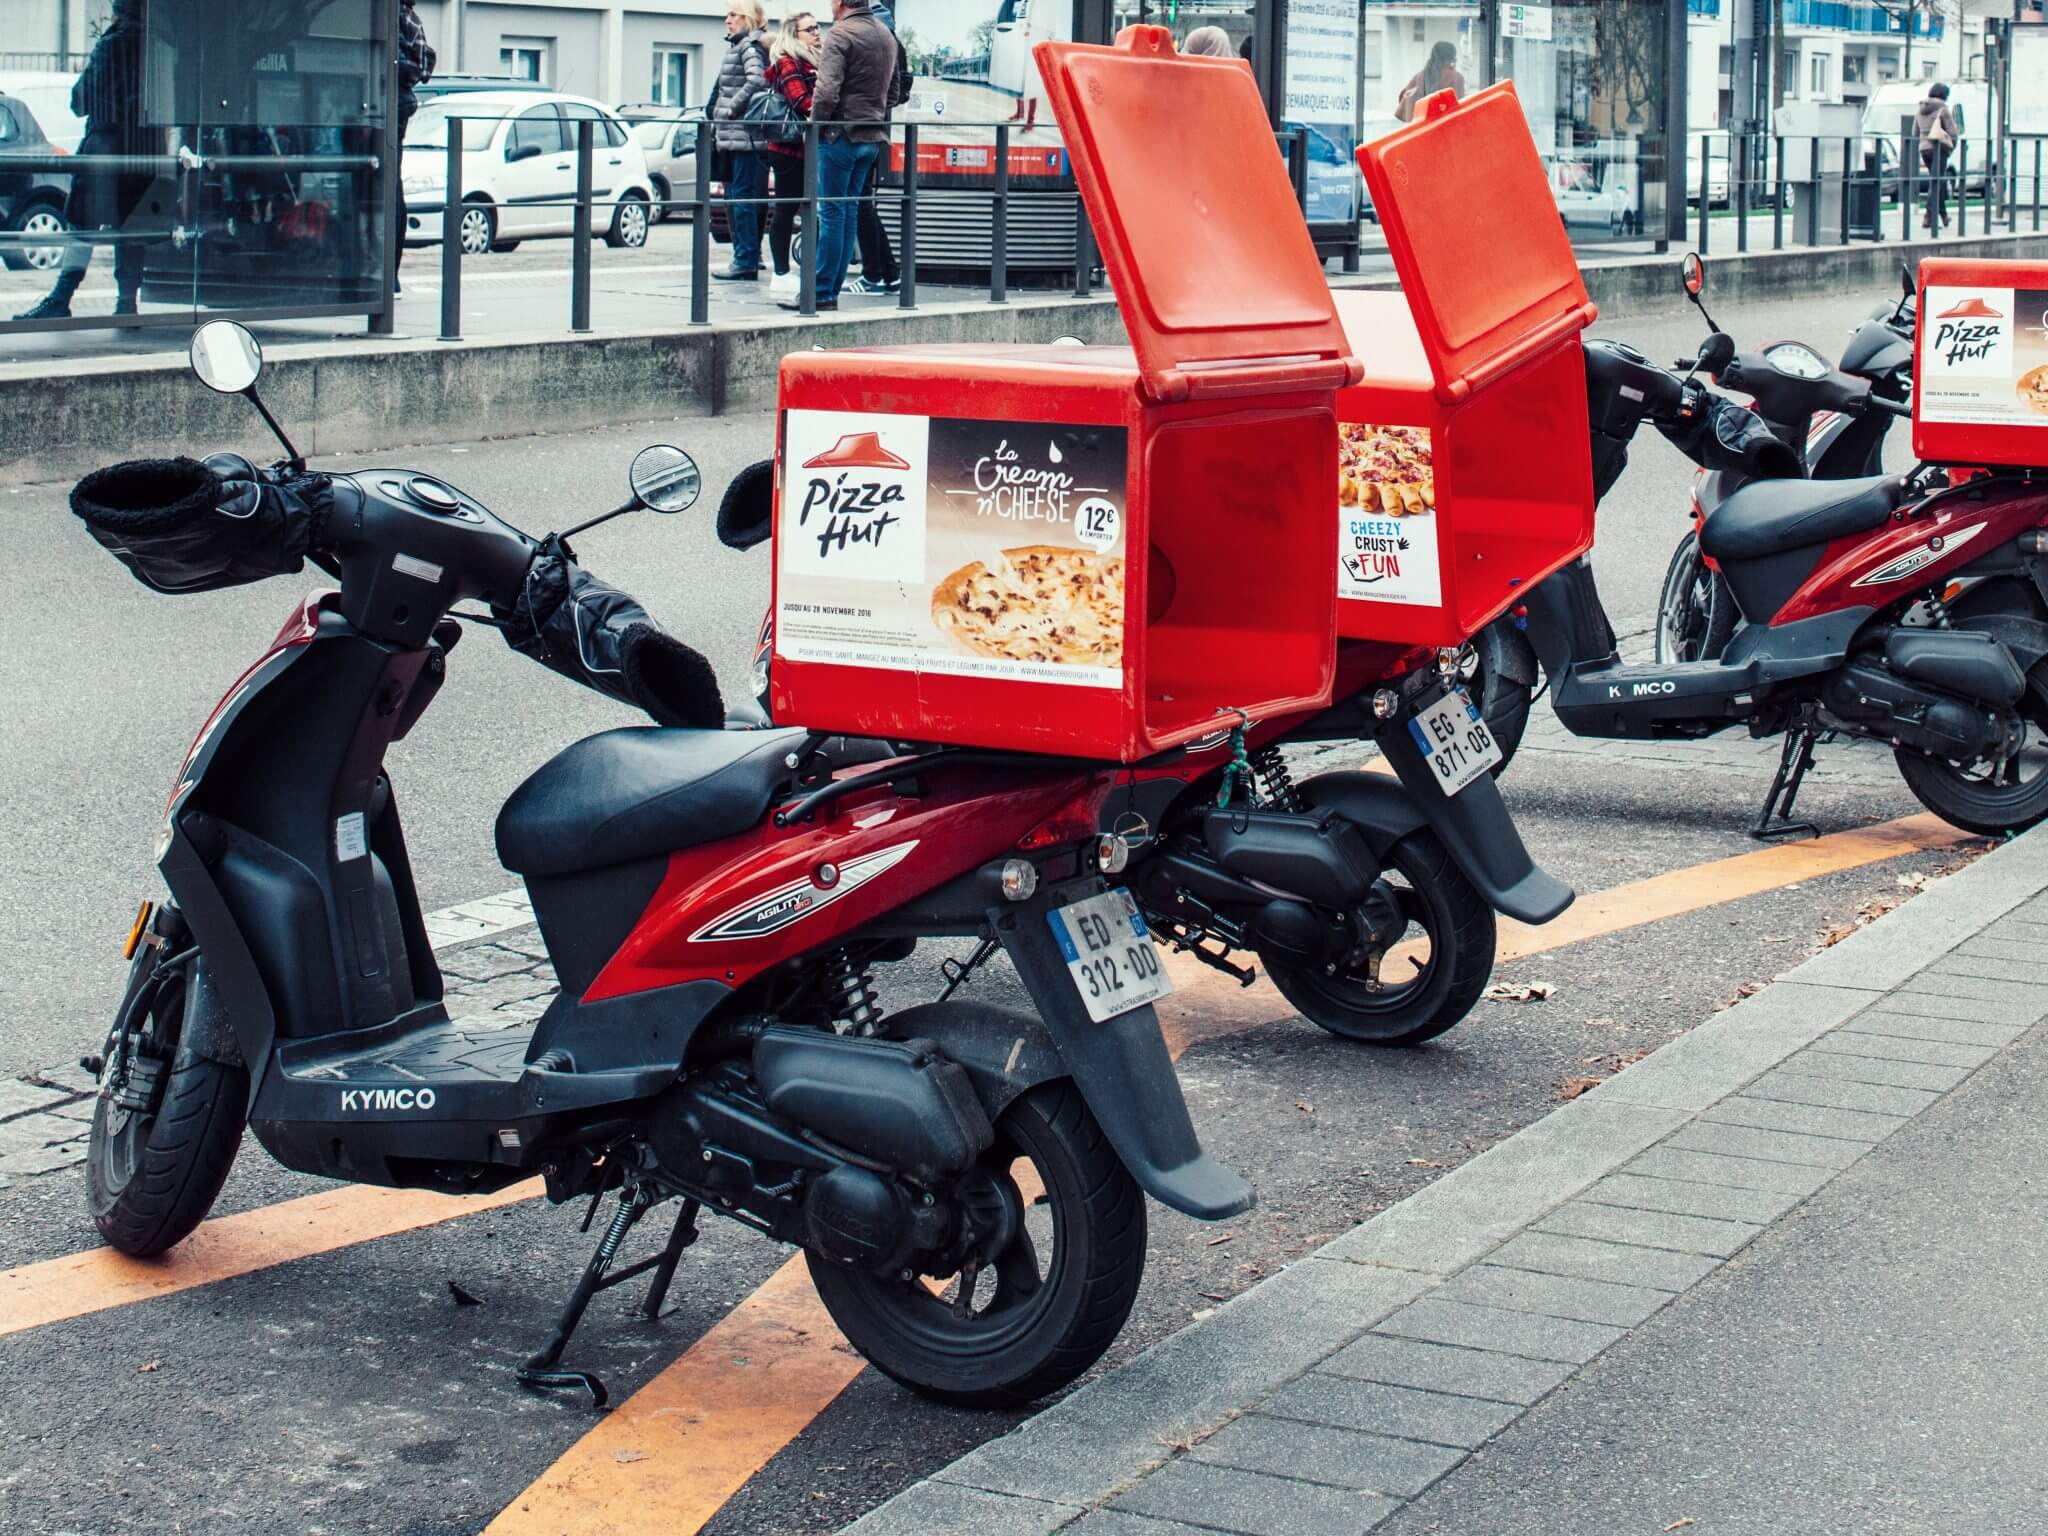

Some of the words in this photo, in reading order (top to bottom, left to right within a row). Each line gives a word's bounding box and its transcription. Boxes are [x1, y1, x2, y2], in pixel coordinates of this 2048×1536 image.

[1935, 320, 2000, 349] Pizza
[1946, 340, 1998, 366] Hut
[994, 439, 1019, 461] La
[974, 456, 1074, 492] Cream
[800, 472, 905, 526] Pizza
[817, 511, 900, 558] Hut
[1350, 521, 1401, 536] CHEEZY
[1355, 536, 1395, 553] CRUST
[1358, 553, 1400, 579] FUN
[823, 606, 855, 617] NOVEMBRE
[857, 608, 872, 617] 2016
[815, 649, 833, 658] VOTRE
[881, 655, 889, 663] AU
[1428, 712, 1455, 743] EG
[756, 893, 804, 923] AGILITY
[1077, 913, 1111, 952] ED
[341, 1087, 436, 1111] KYMCO
